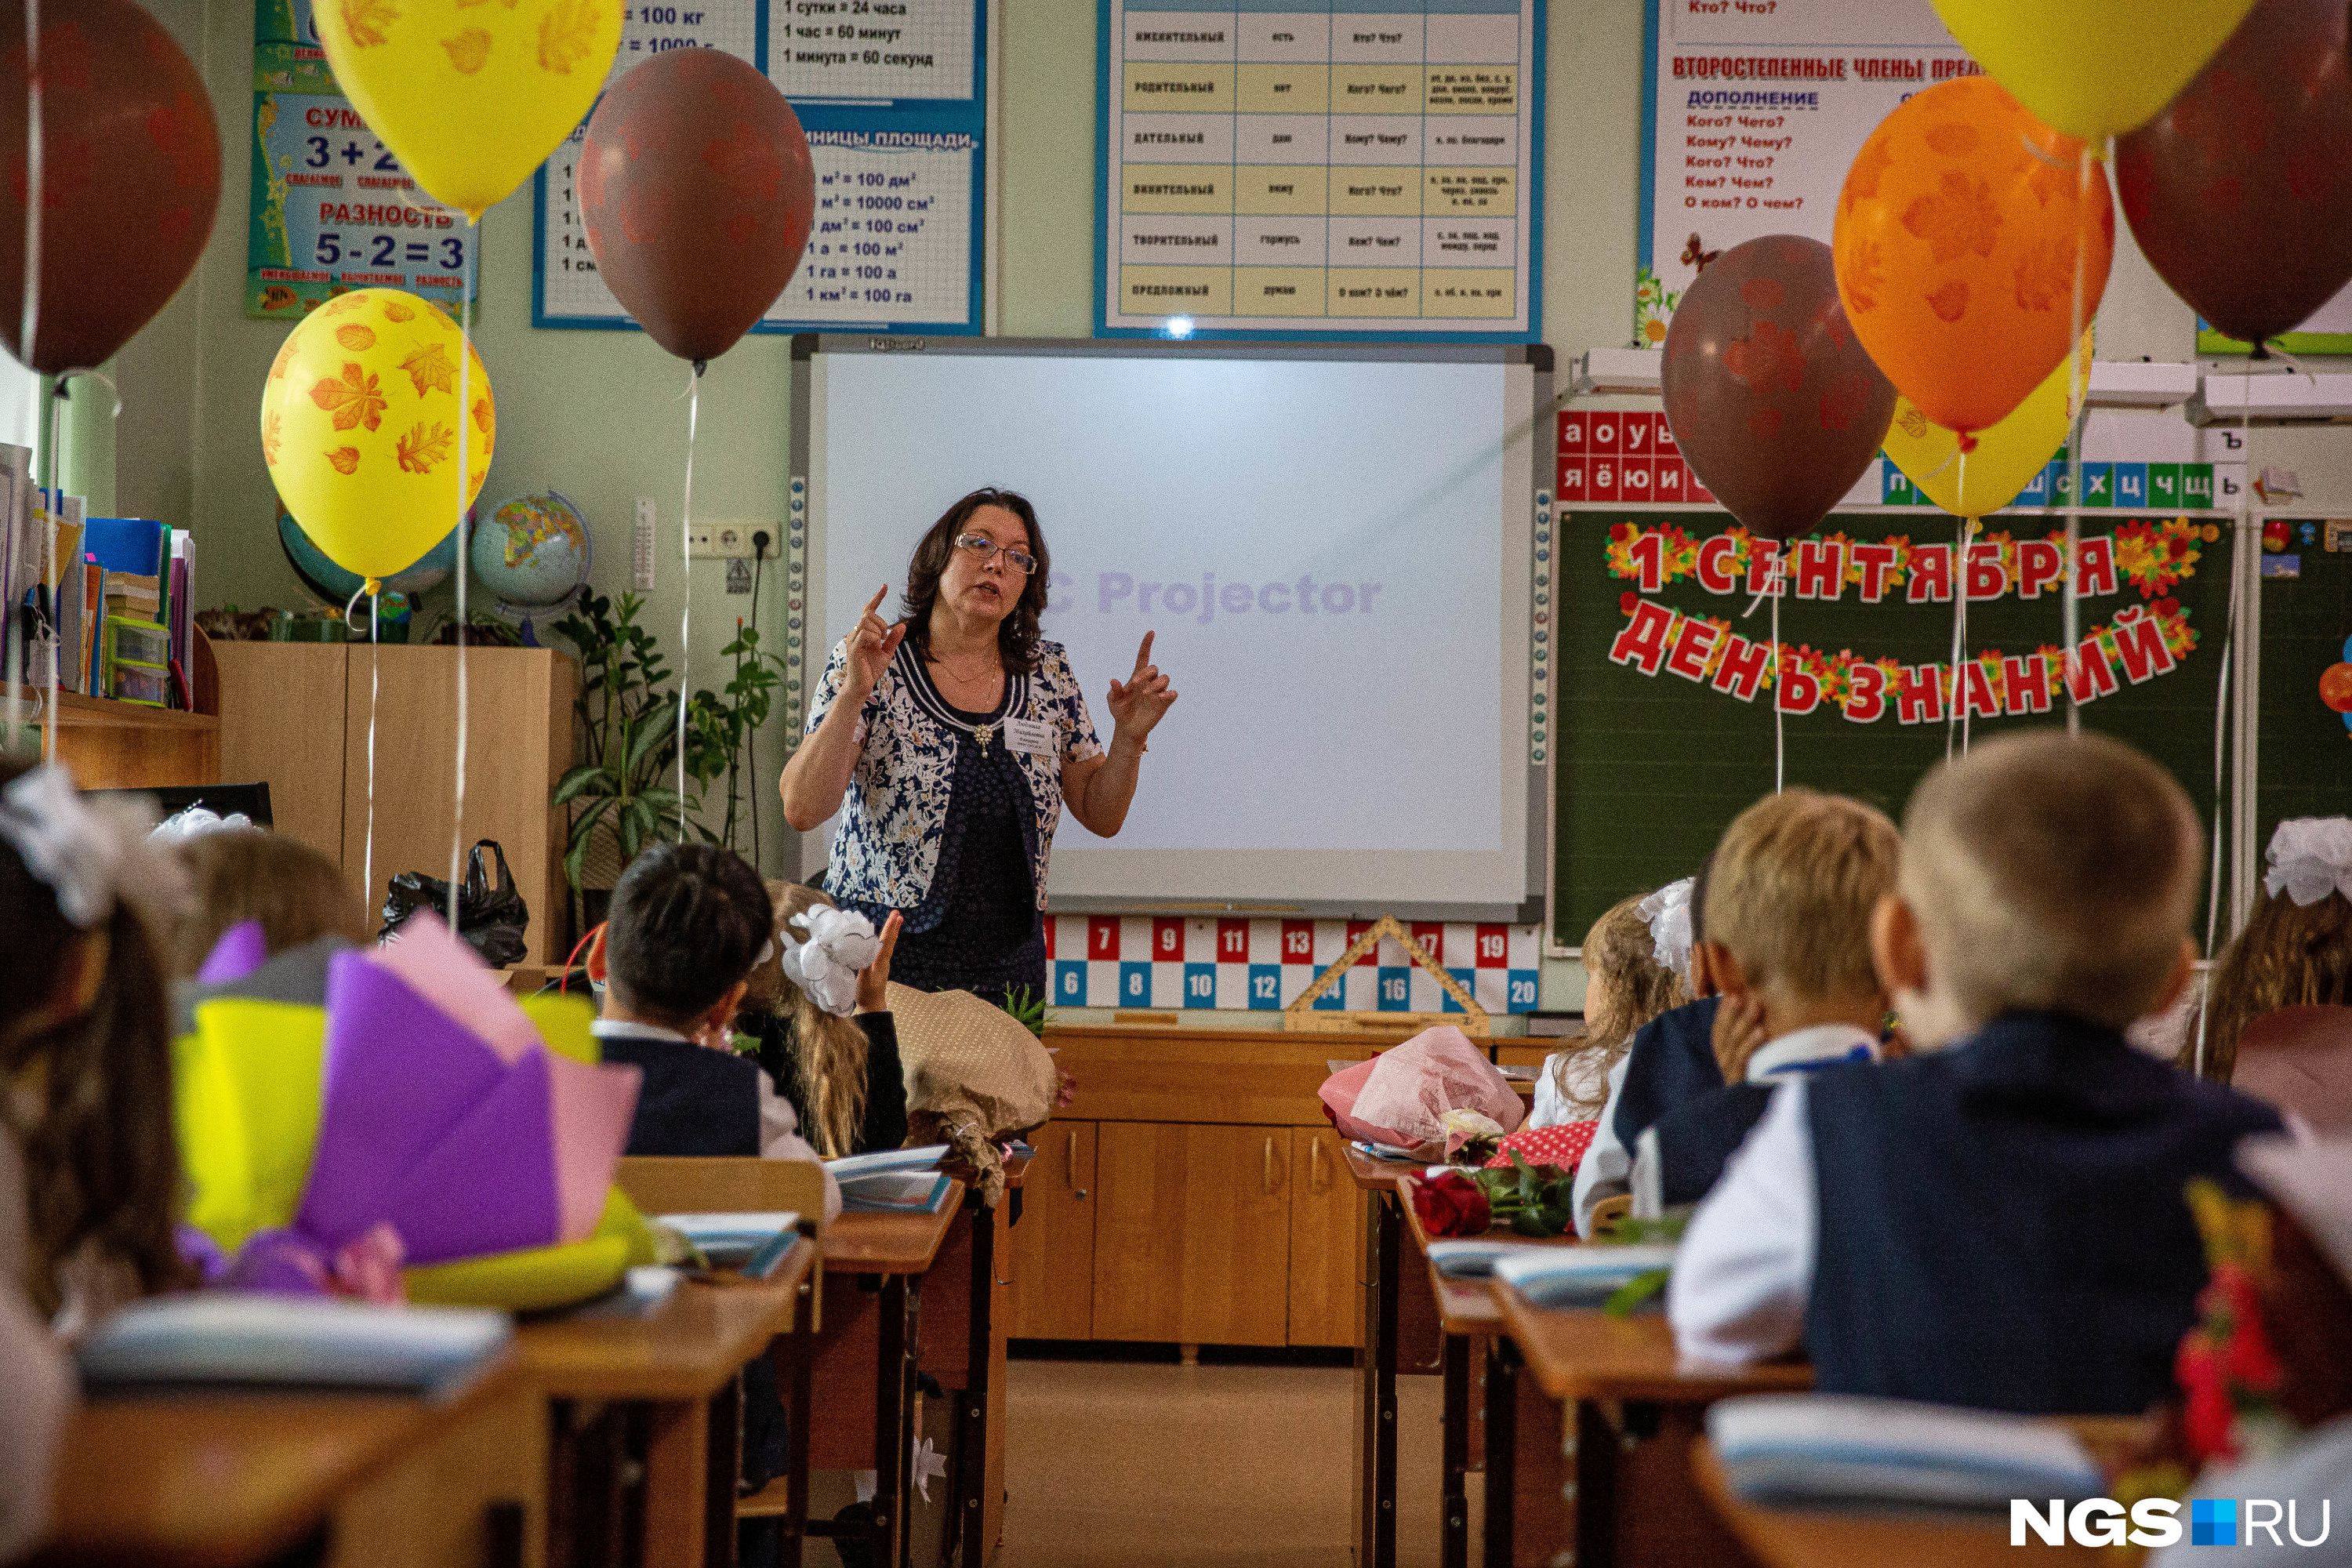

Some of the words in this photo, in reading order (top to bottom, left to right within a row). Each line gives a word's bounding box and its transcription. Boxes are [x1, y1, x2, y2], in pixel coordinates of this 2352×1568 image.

[641, 7, 676, 24] 100
[683, 12, 705, 24] кг
[796, 3, 835, 16] сутки
[851, 2, 869, 14] 24
[874, 5, 906, 15] часа
[1689, 1, 1728, 13] Кто?
[1735, 1, 1777, 14] Что?
[785, 24, 792, 38] 1
[796, 27, 821, 38] час
[838, 25, 855, 38] 60
[858, 28, 901, 41] минут
[785, 49, 792, 63] 1
[796, 53, 846, 65] минута
[862, 50, 880, 64] 60
[883, 53, 934, 67] секунд
[1672, 56, 1845, 78] ВТОРОСТЕПЕННЫЕ
[1853, 58, 1922, 78] ЧЛЕНЫ
[1687, 91, 1819, 106] ДОПОЛНЕНИЕ
[1686, 116, 1732, 129] Кого?
[1737, 116, 1784, 129] Чего?
[874, 132, 971, 149] ПЛОЩАДИ
[1686, 136, 1736, 150] Кому?
[1740, 136, 1792, 151] Чему?
[306, 136, 329, 167] 3
[1686, 156, 1731, 169] Кого?
[1736, 156, 1774, 169] Что?
[858, 173, 884, 186] 100
[1686, 176, 1726, 188] Кем?
[1731, 176, 1774, 189] Чем?
[858, 197, 902, 210] 10000
[1701, 197, 1740, 209] ком?
[319, 202, 452, 226] РАЗНОСТЬ
[866, 220, 892, 233] 100
[316, 233, 341, 264] 5
[370, 235, 395, 267] 2
[440, 238, 463, 269] 3
[821, 245, 829, 255] а
[855, 242, 880, 256] 100
[820, 268, 836, 278] га
[856, 266, 882, 279] 100
[887, 269, 897, 279] а
[865, 289, 891, 302] 100
[895, 292, 912, 303] га
[1565, 423, 1581, 442] а
[1595, 423, 1614, 443] о
[1629, 423, 1646, 449] у
[1565, 470, 1581, 488] я
[1624, 470, 1650, 488] ю
[1661, 470, 1679, 488] и
[2089, 475, 2106, 493] х
[2122, 475, 2141, 498] ц
[2156, 475, 2173, 494] ч
[2185, 477, 2210, 499] щ
[1628, 532, 1664, 592] 1
[1696, 534, 2118, 603] СЕНТЯБРЯ
[1098, 572, 1383, 625] Projector
[1609, 599, 1820, 714] ДЕНЬ
[1844, 604, 2176, 724] ЗНАНИЙ
[1098, 927, 1111, 949] 7
[1161, 927, 1176, 950] 9
[1223, 928, 1244, 952] 11
[1286, 931, 1310, 953] 13
[1480, 935, 1504, 958] 19
[1064, 971, 1079, 995] 6
[1129, 972, 1144, 996] 8
[1189, 973, 1213, 997] 10
[1254, 975, 1276, 998] 12
[1383, 978, 1406, 1000] 16
[1511, 980, 1535, 1004] 20
